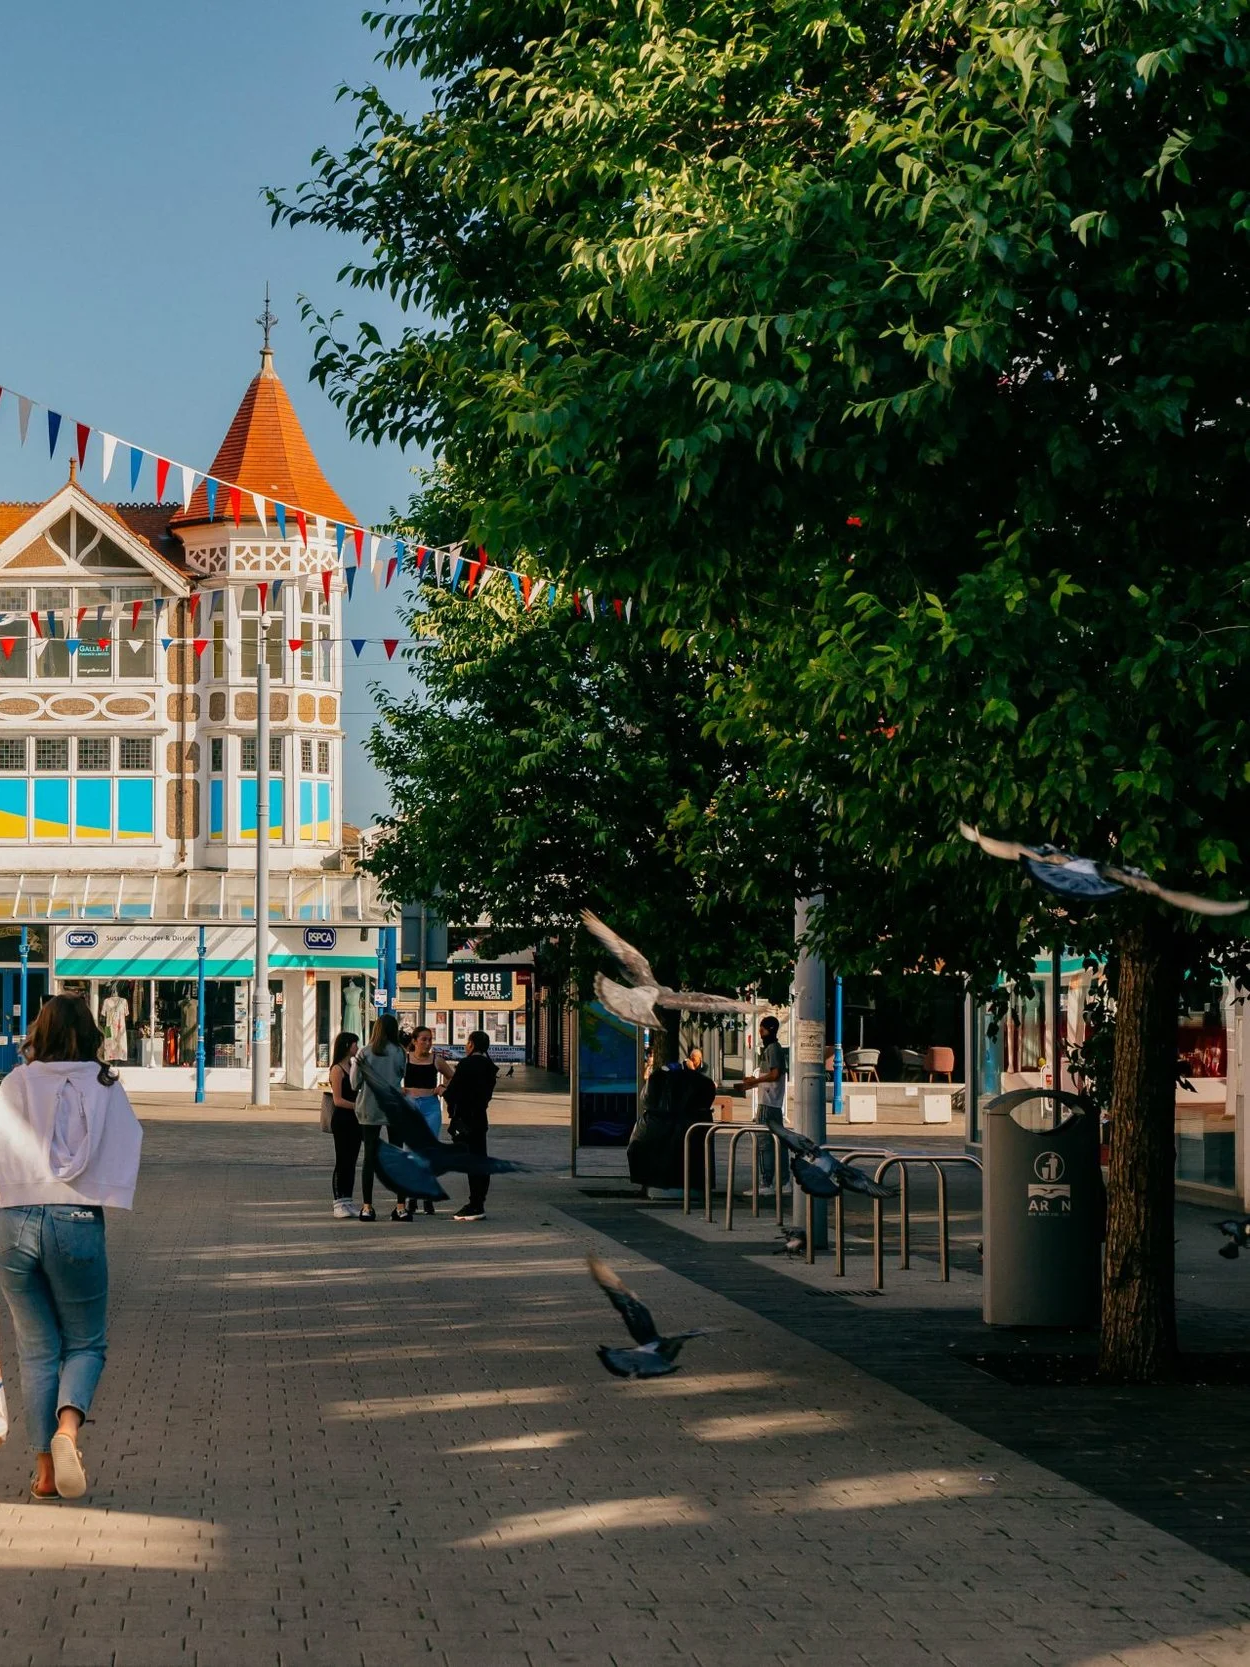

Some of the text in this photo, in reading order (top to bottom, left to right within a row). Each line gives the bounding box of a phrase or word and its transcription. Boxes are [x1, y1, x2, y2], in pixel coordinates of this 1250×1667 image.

[69, 934, 95, 945] RSPCA
[106, 934, 127, 942] Sussex
[129, 934, 164, 942] Chichester
[172, 934, 197, 942] District
[308, 932, 333, 943] RSPCA
[464, 972, 502, 983] REGIS
[464, 983, 502, 992] CENTRE
[1028, 1200, 1071, 1212] ARN
